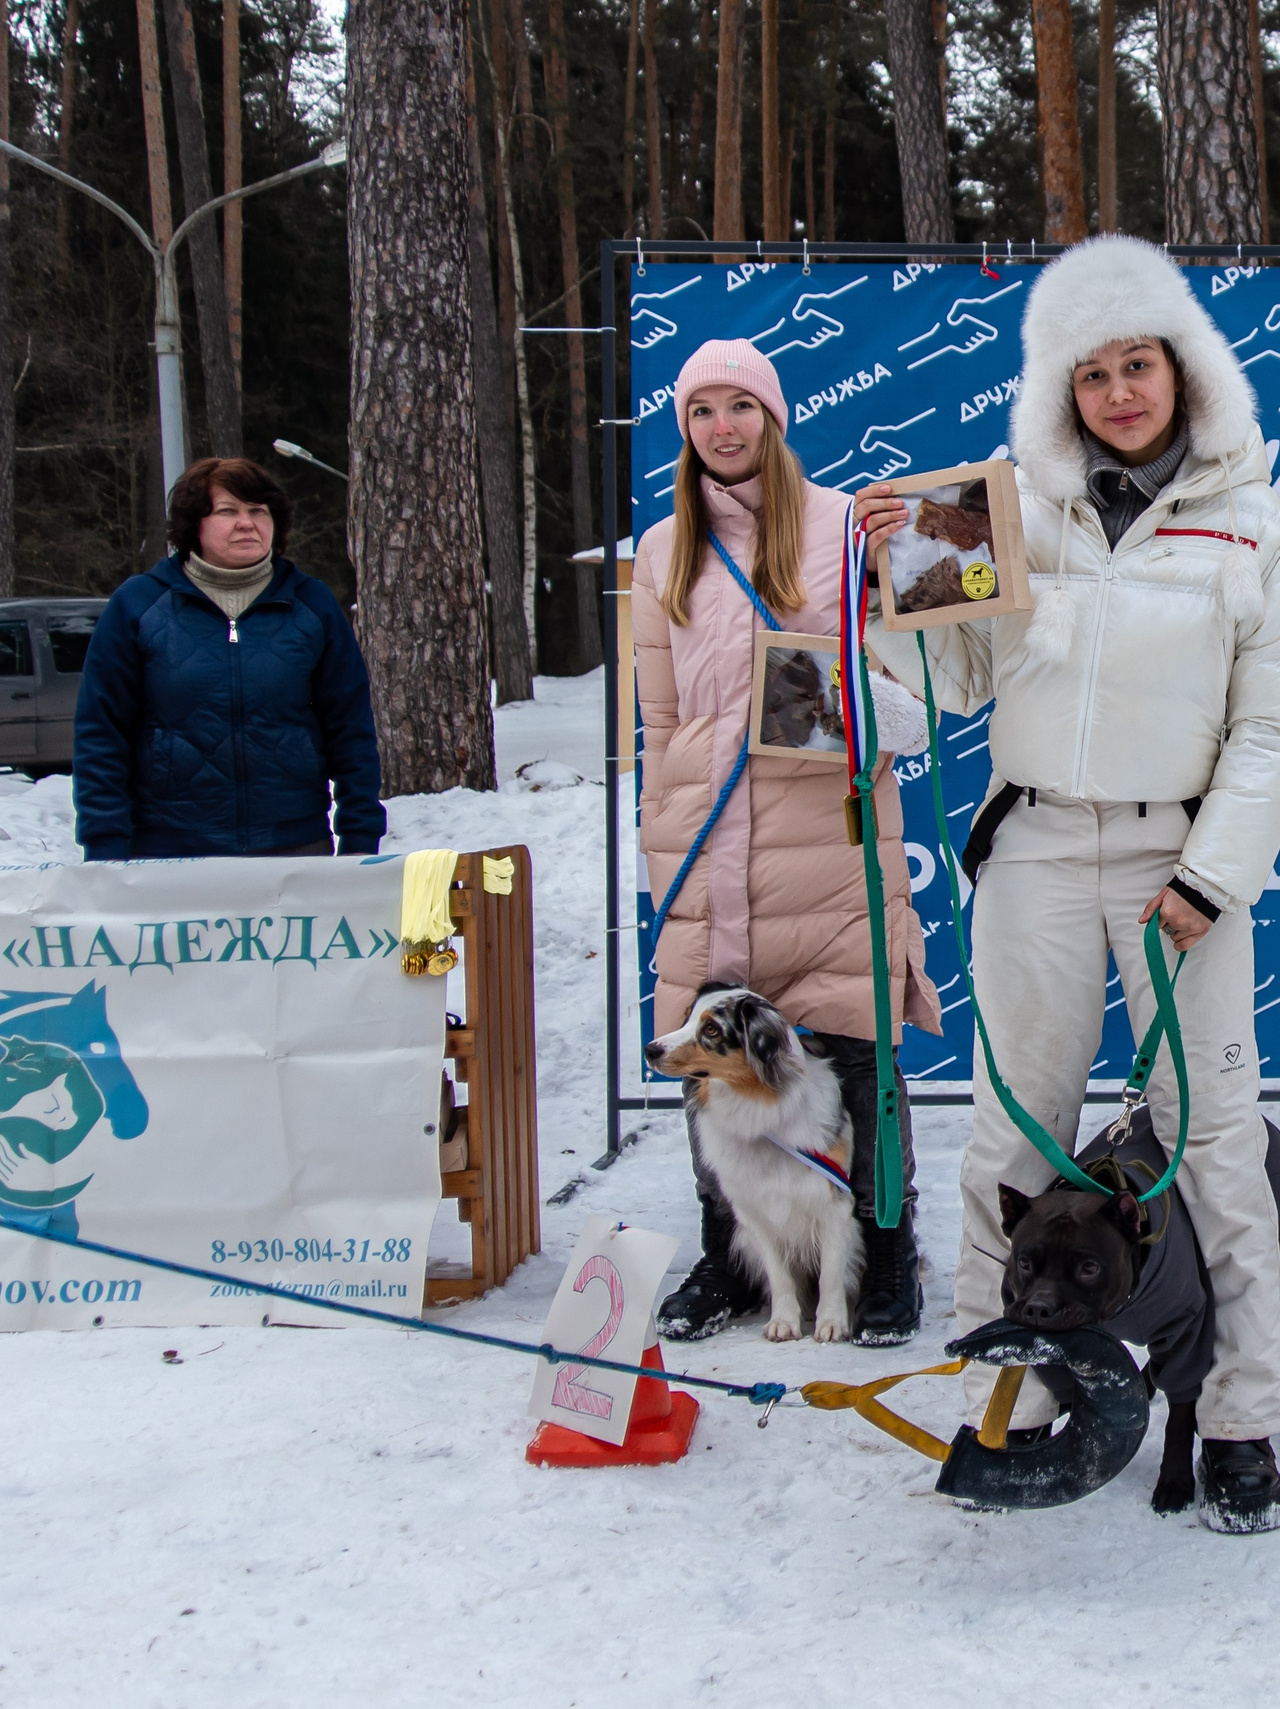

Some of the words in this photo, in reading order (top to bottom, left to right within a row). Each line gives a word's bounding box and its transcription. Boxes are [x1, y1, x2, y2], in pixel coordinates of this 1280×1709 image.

[794, 362, 892, 424] ДРУЖБА
[3, 916, 399, 977] «НАДЕЖДА»
[210, 1237, 412, 1264] 8-930-804-31-88
[0, 1279, 142, 1305] ov.com
[551, 1255, 625, 1421] 2
